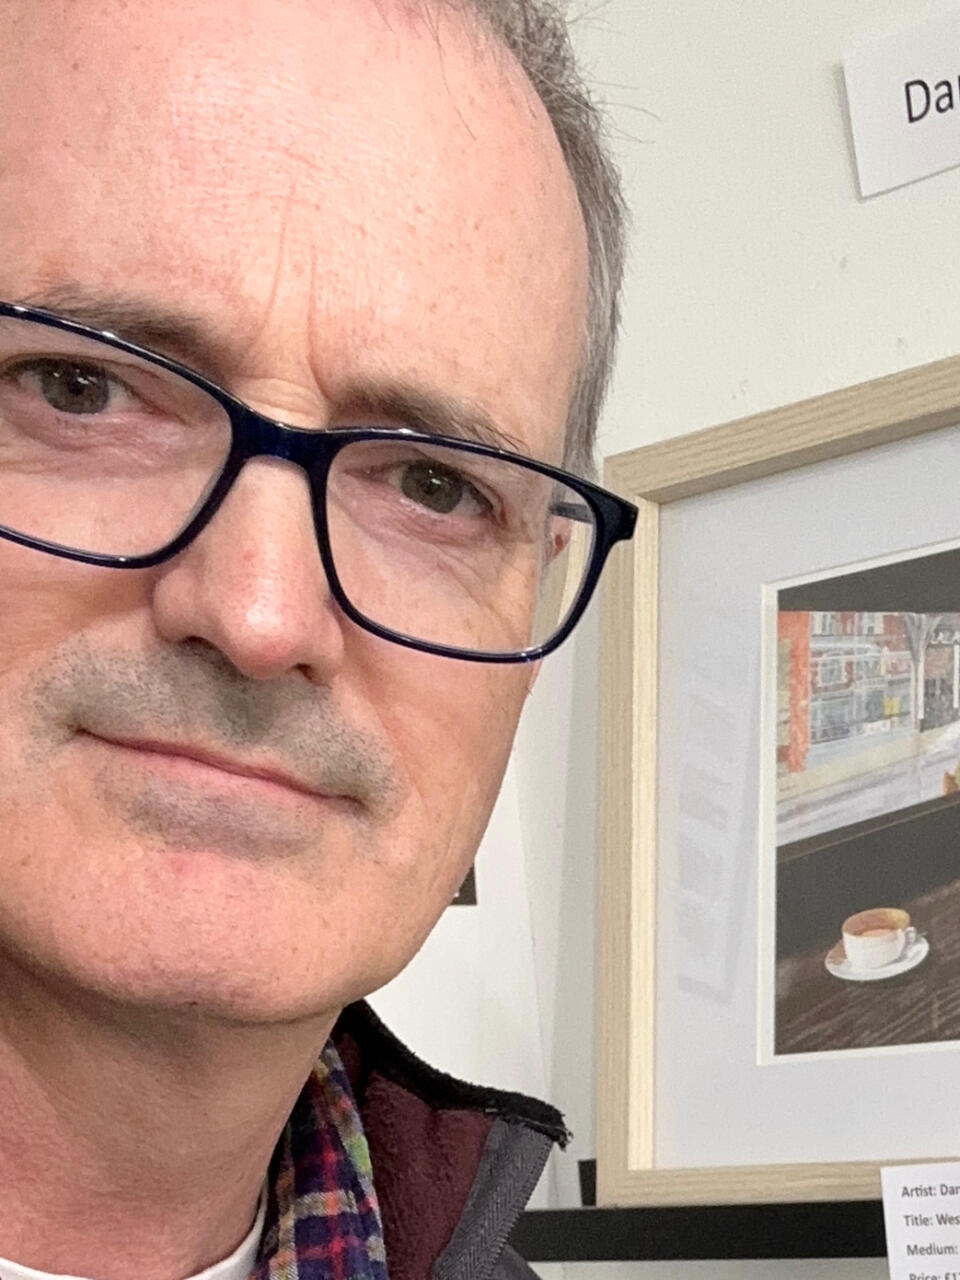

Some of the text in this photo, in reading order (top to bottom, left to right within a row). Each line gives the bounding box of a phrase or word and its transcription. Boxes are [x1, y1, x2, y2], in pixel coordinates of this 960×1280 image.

[901, 1185, 937, 1198] Artist:
[904, 1214, 933, 1227] Title:
[906, 1242, 959, 1257] Medium:
